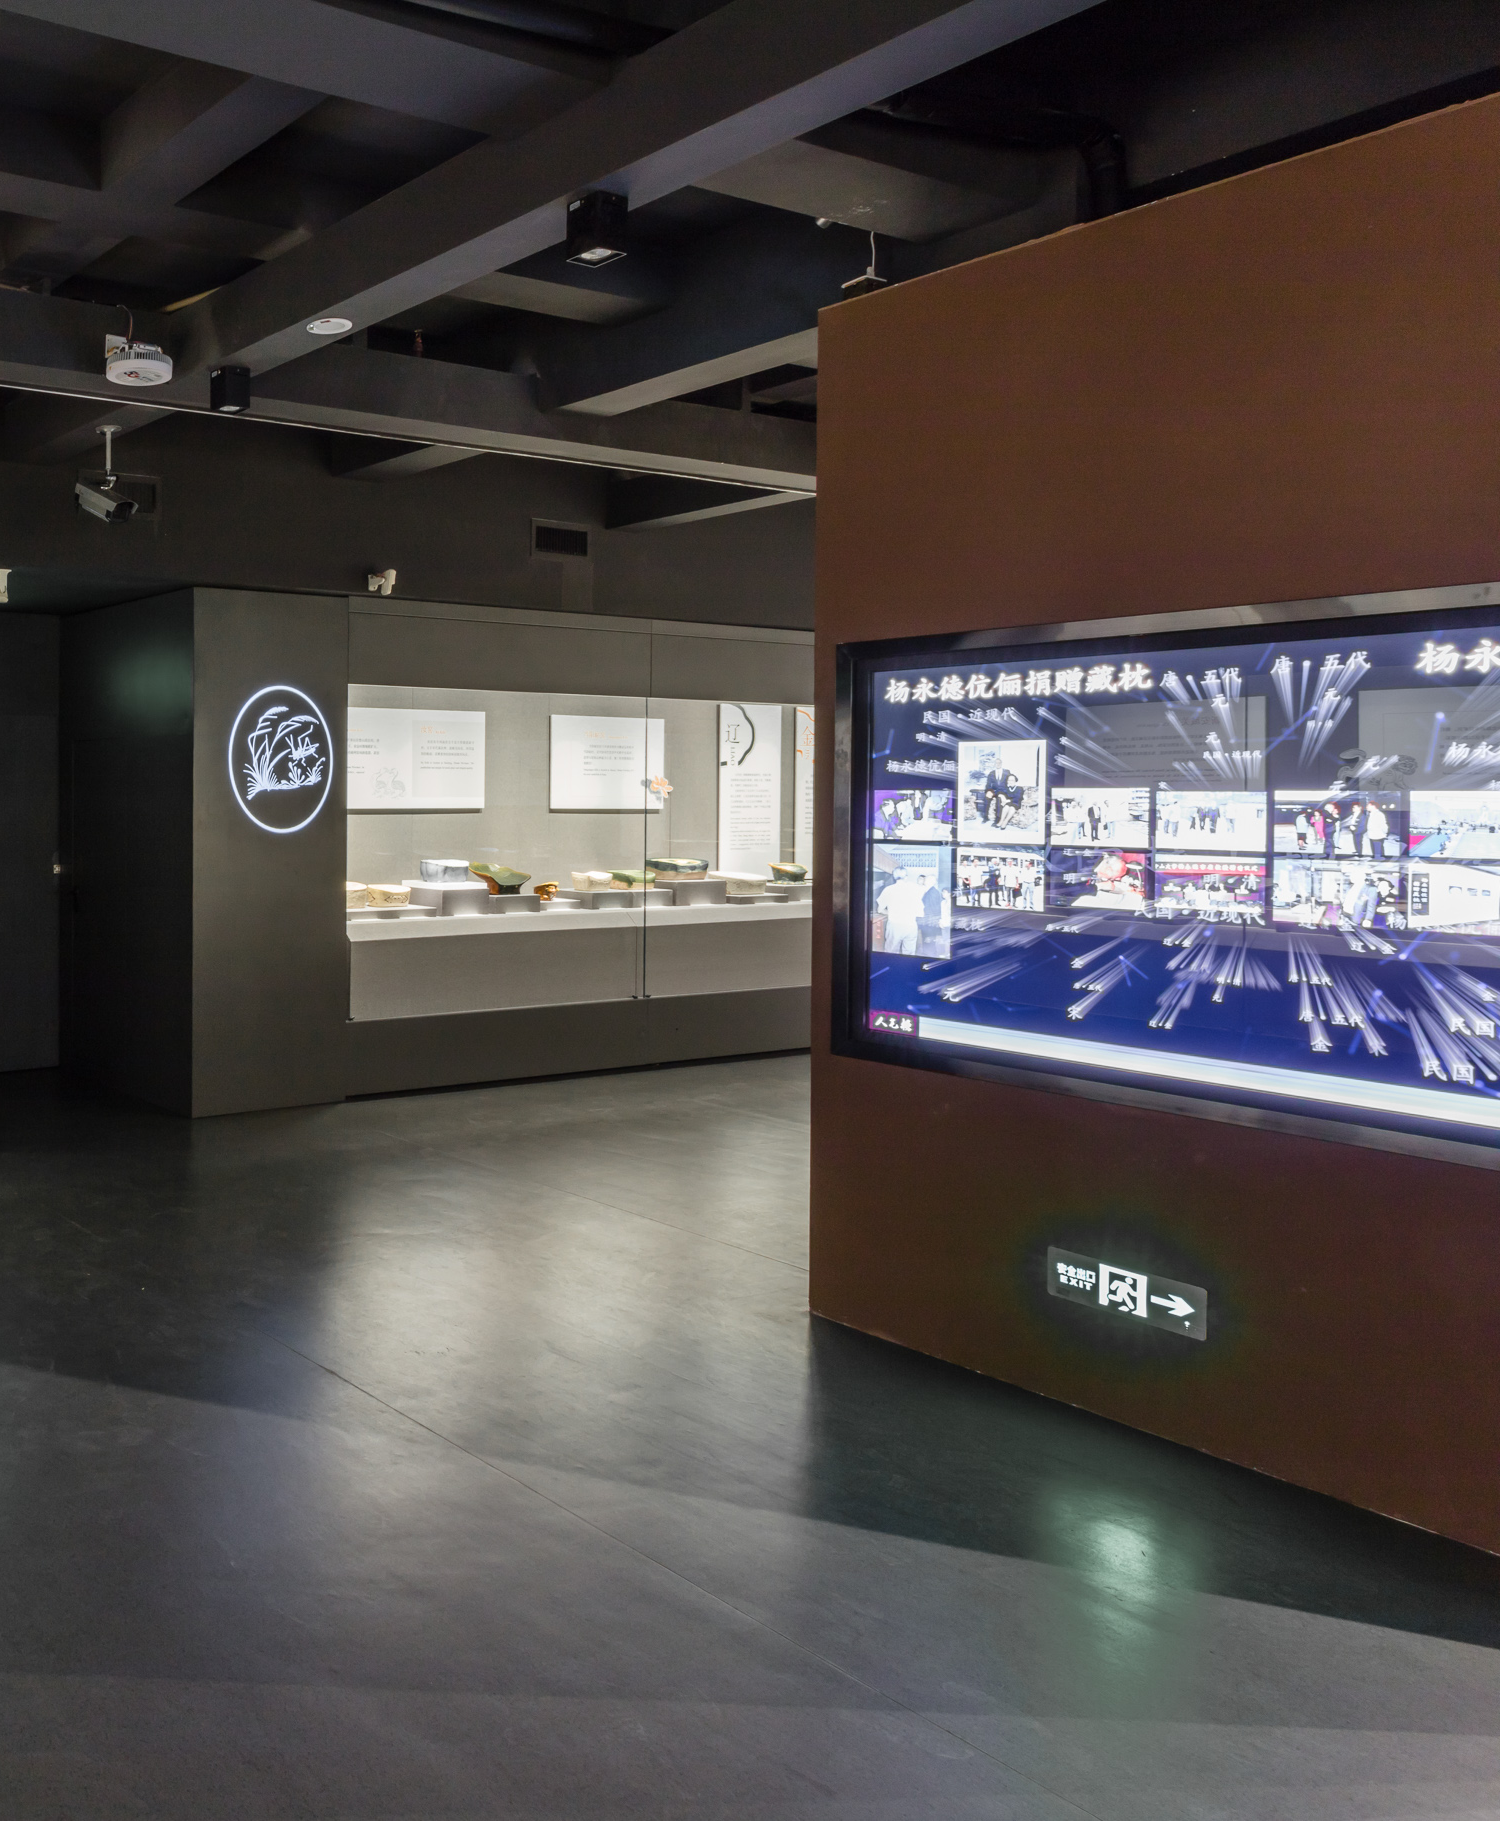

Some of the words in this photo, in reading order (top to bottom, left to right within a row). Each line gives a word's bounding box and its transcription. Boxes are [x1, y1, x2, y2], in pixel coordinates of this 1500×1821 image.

[885, 663, 1153, 703] 杨永德伉俪捐赠藏枕
[725, 724, 740, 743] 辽
[1056, 1262, 1096, 1284] 安全出口
[1059, 1275, 1093, 1292] EXIT
